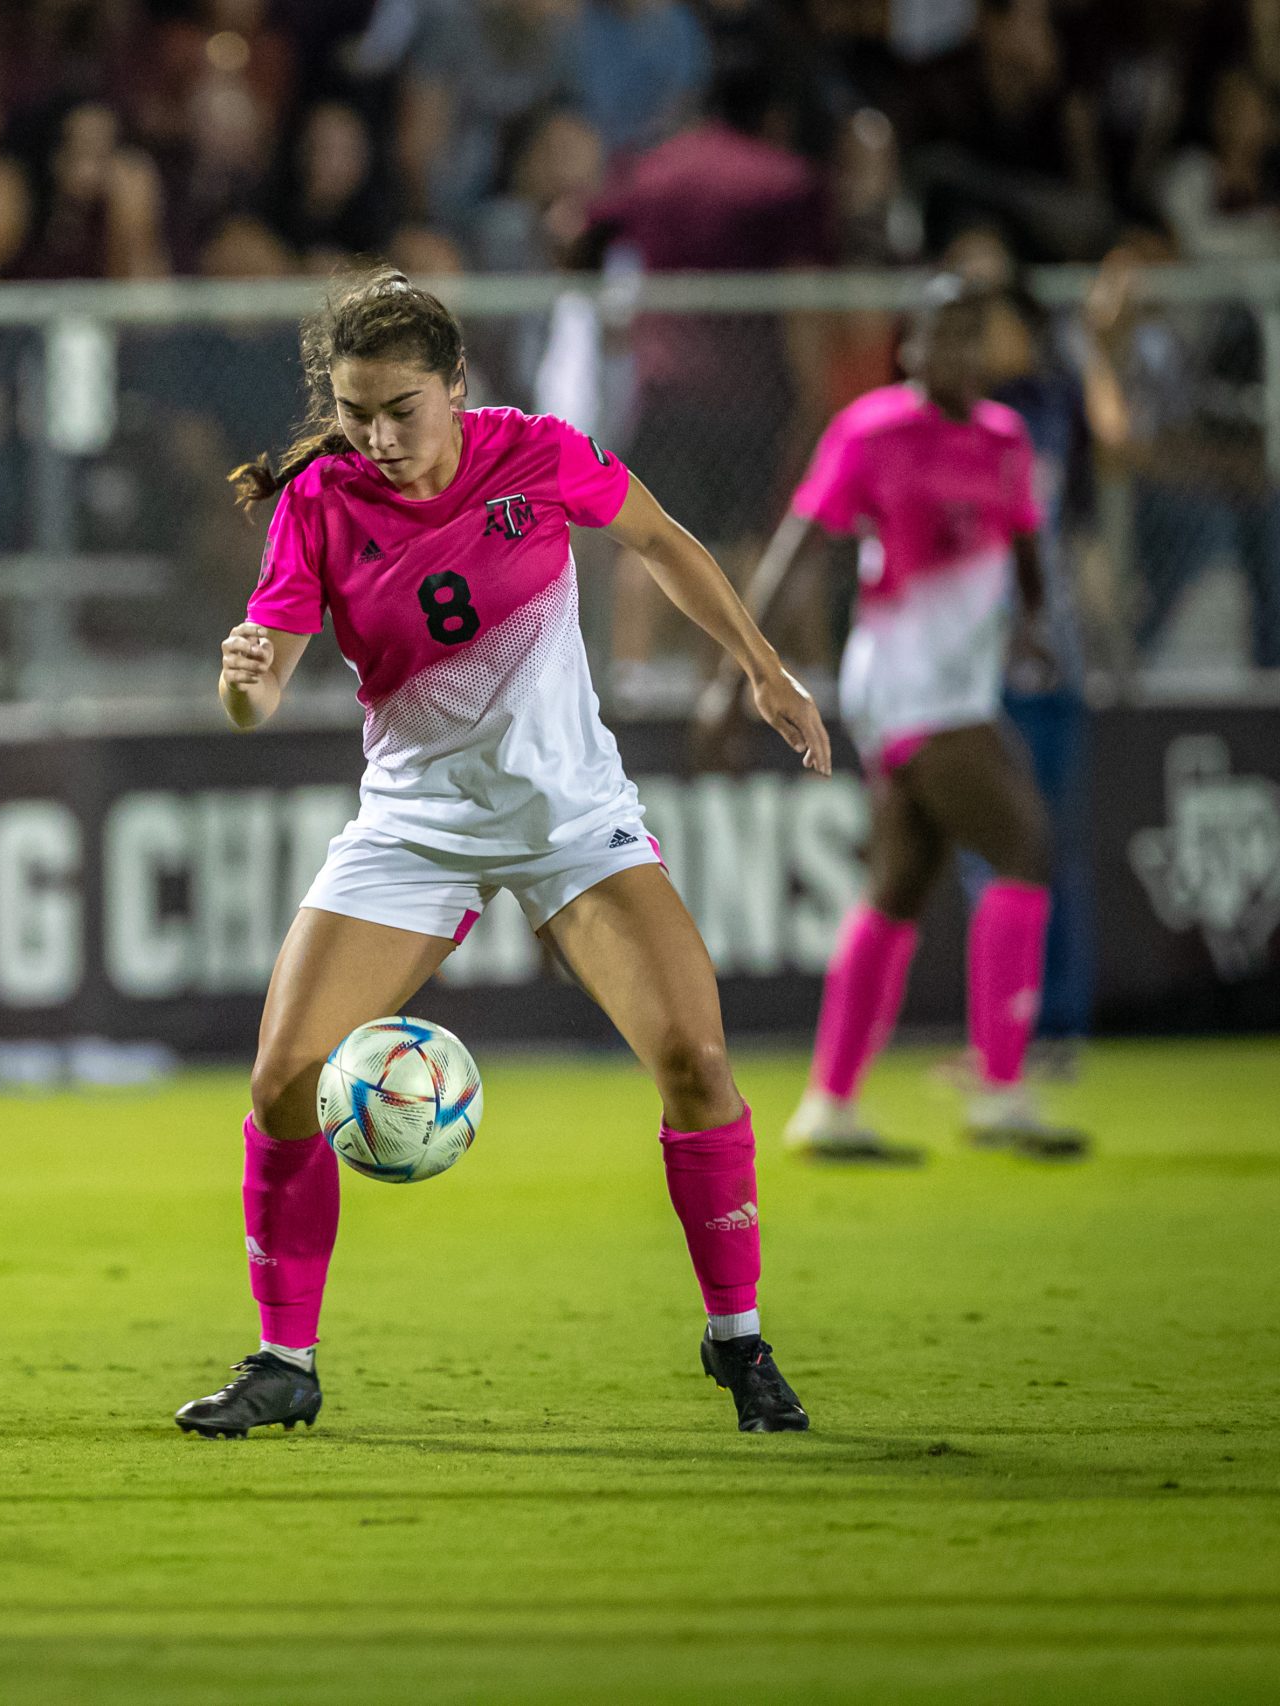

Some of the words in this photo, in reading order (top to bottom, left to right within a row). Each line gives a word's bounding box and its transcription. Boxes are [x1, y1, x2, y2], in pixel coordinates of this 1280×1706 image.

[417, 570, 480, 646] 8
[608, 834, 639, 849] adidas
[704, 1216, 758, 1231] adida
